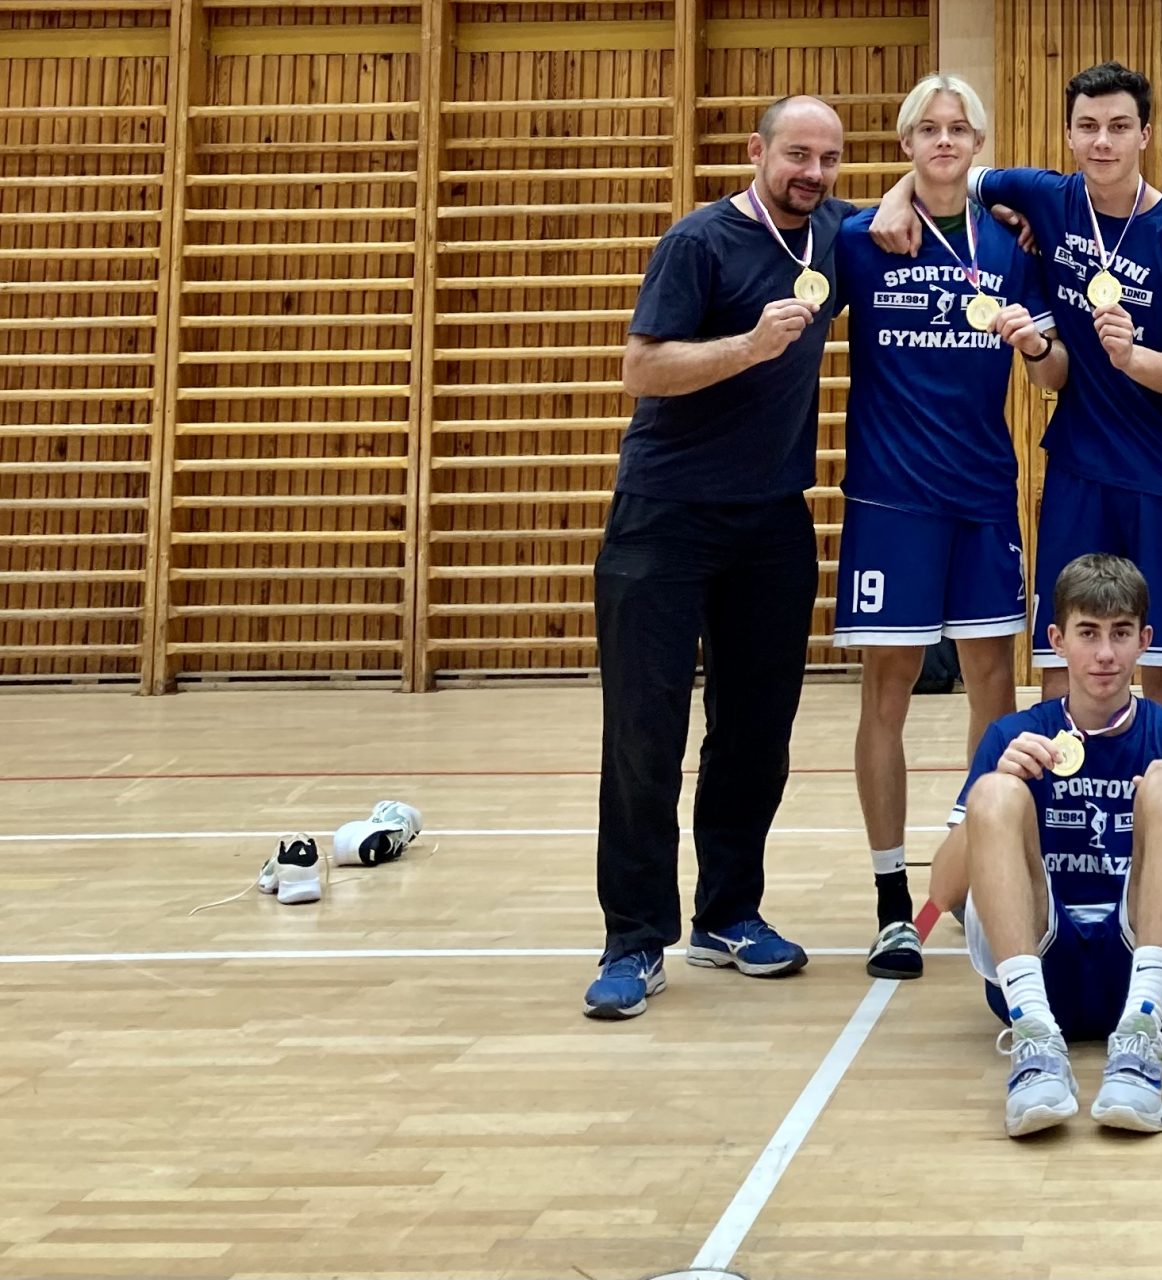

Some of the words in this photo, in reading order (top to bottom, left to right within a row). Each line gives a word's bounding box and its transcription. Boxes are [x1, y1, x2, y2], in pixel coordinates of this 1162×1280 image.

[883, 265, 1003, 292] SPORTONÍ
[876, 294, 899, 304] EST.
[901, 295, 926, 304] 1984
[1121, 287, 1147, 301] ADNO
[878, 329, 1002, 350] GYMNÁZIUM
[852, 570, 885, 613] 19
